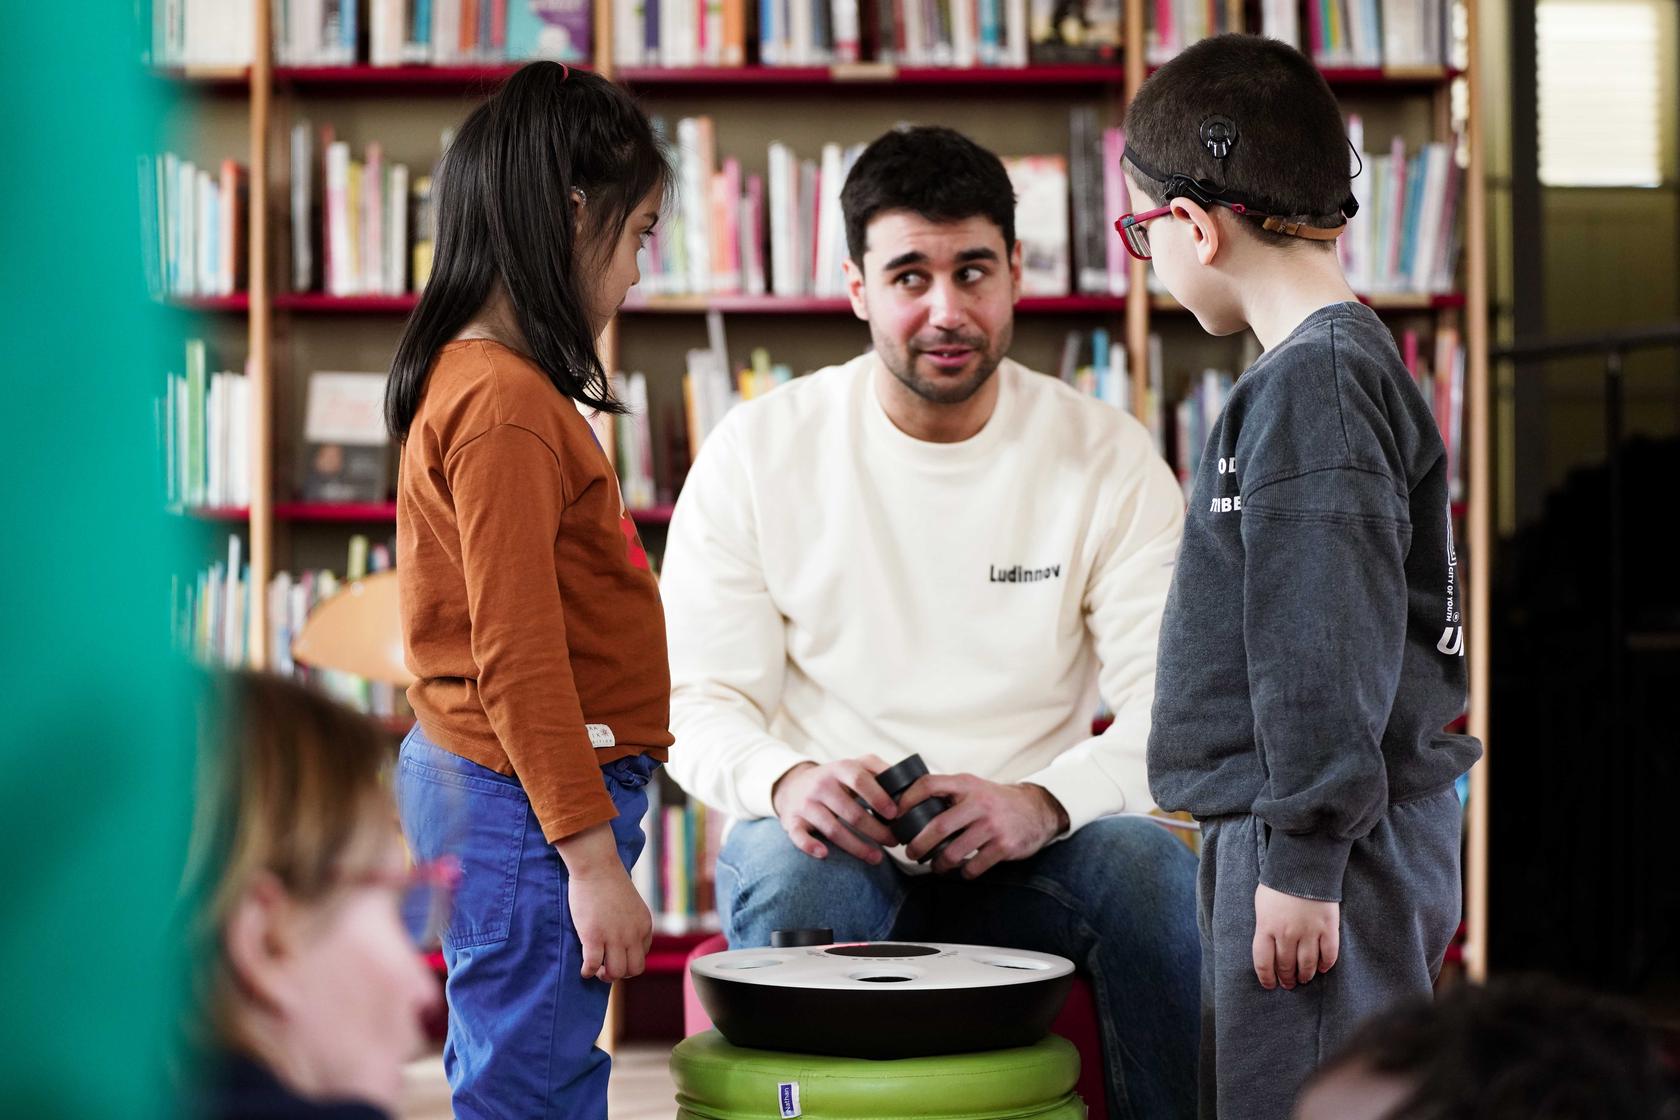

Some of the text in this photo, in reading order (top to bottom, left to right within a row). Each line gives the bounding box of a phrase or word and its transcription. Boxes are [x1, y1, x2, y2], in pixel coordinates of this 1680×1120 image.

[990, 564, 1061, 583] Ludinnov
[1446, 585, 1454, 596] OF
[1446, 596, 1454, 622] YOUTH
